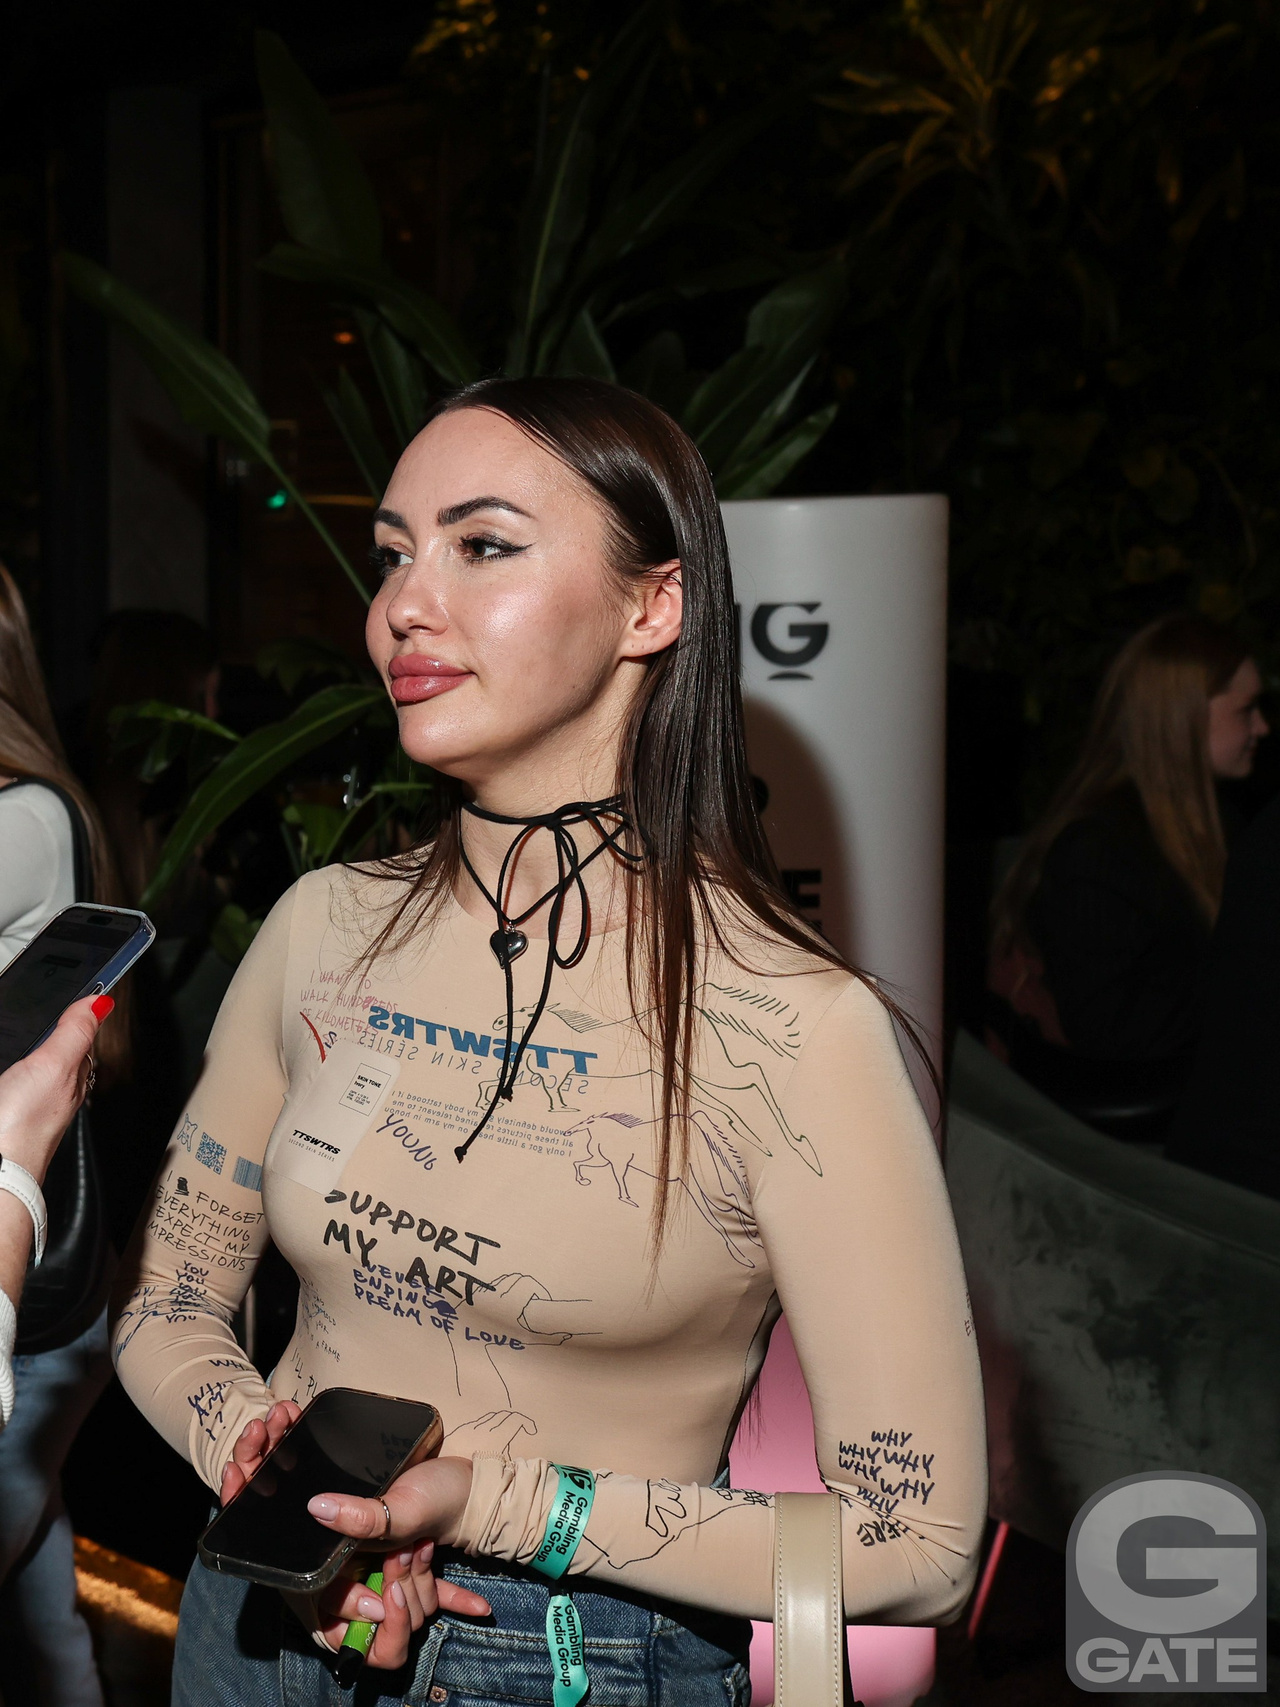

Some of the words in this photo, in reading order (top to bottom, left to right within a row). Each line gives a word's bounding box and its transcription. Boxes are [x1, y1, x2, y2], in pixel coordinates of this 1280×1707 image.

[300, 989, 329, 1002] WALK
[292, 1129, 341, 1154] TTSWTRS
[376, 1114, 438, 1171] YOUNG
[156, 1185, 250, 1241] EVERYTHING
[196, 1191, 265, 1225] FORGET
[156, 1205, 220, 1245] EXPECT
[224, 1241, 250, 1256] MY
[175, 1269, 205, 1285] YOU
[183, 1260, 209, 1276] YOU
[323, 1218, 378, 1267] MY
[405, 1256, 497, 1306] ART
[353, 1282, 423, 1326] DREAM
[430, 1315, 455, 1335] OF
[465, 1327, 525, 1350] LOVE
[871, 1428, 913, 1447] WHY
[838, 1440, 881, 1464] WHY
[883, 1449, 935, 1478] WHY
[838, 1454, 882, 1482] WHY
[880, 1477, 935, 1505] WHY
[554, 1490, 577, 1530] Media
[556, 1496, 588, 1556] Gambling
[537, 1530, 562, 1563] Group
[553, 1605, 564, 1645] Media
[564, 1603, 582, 1666] Gambling
[557, 1647, 571, 1687] Group
